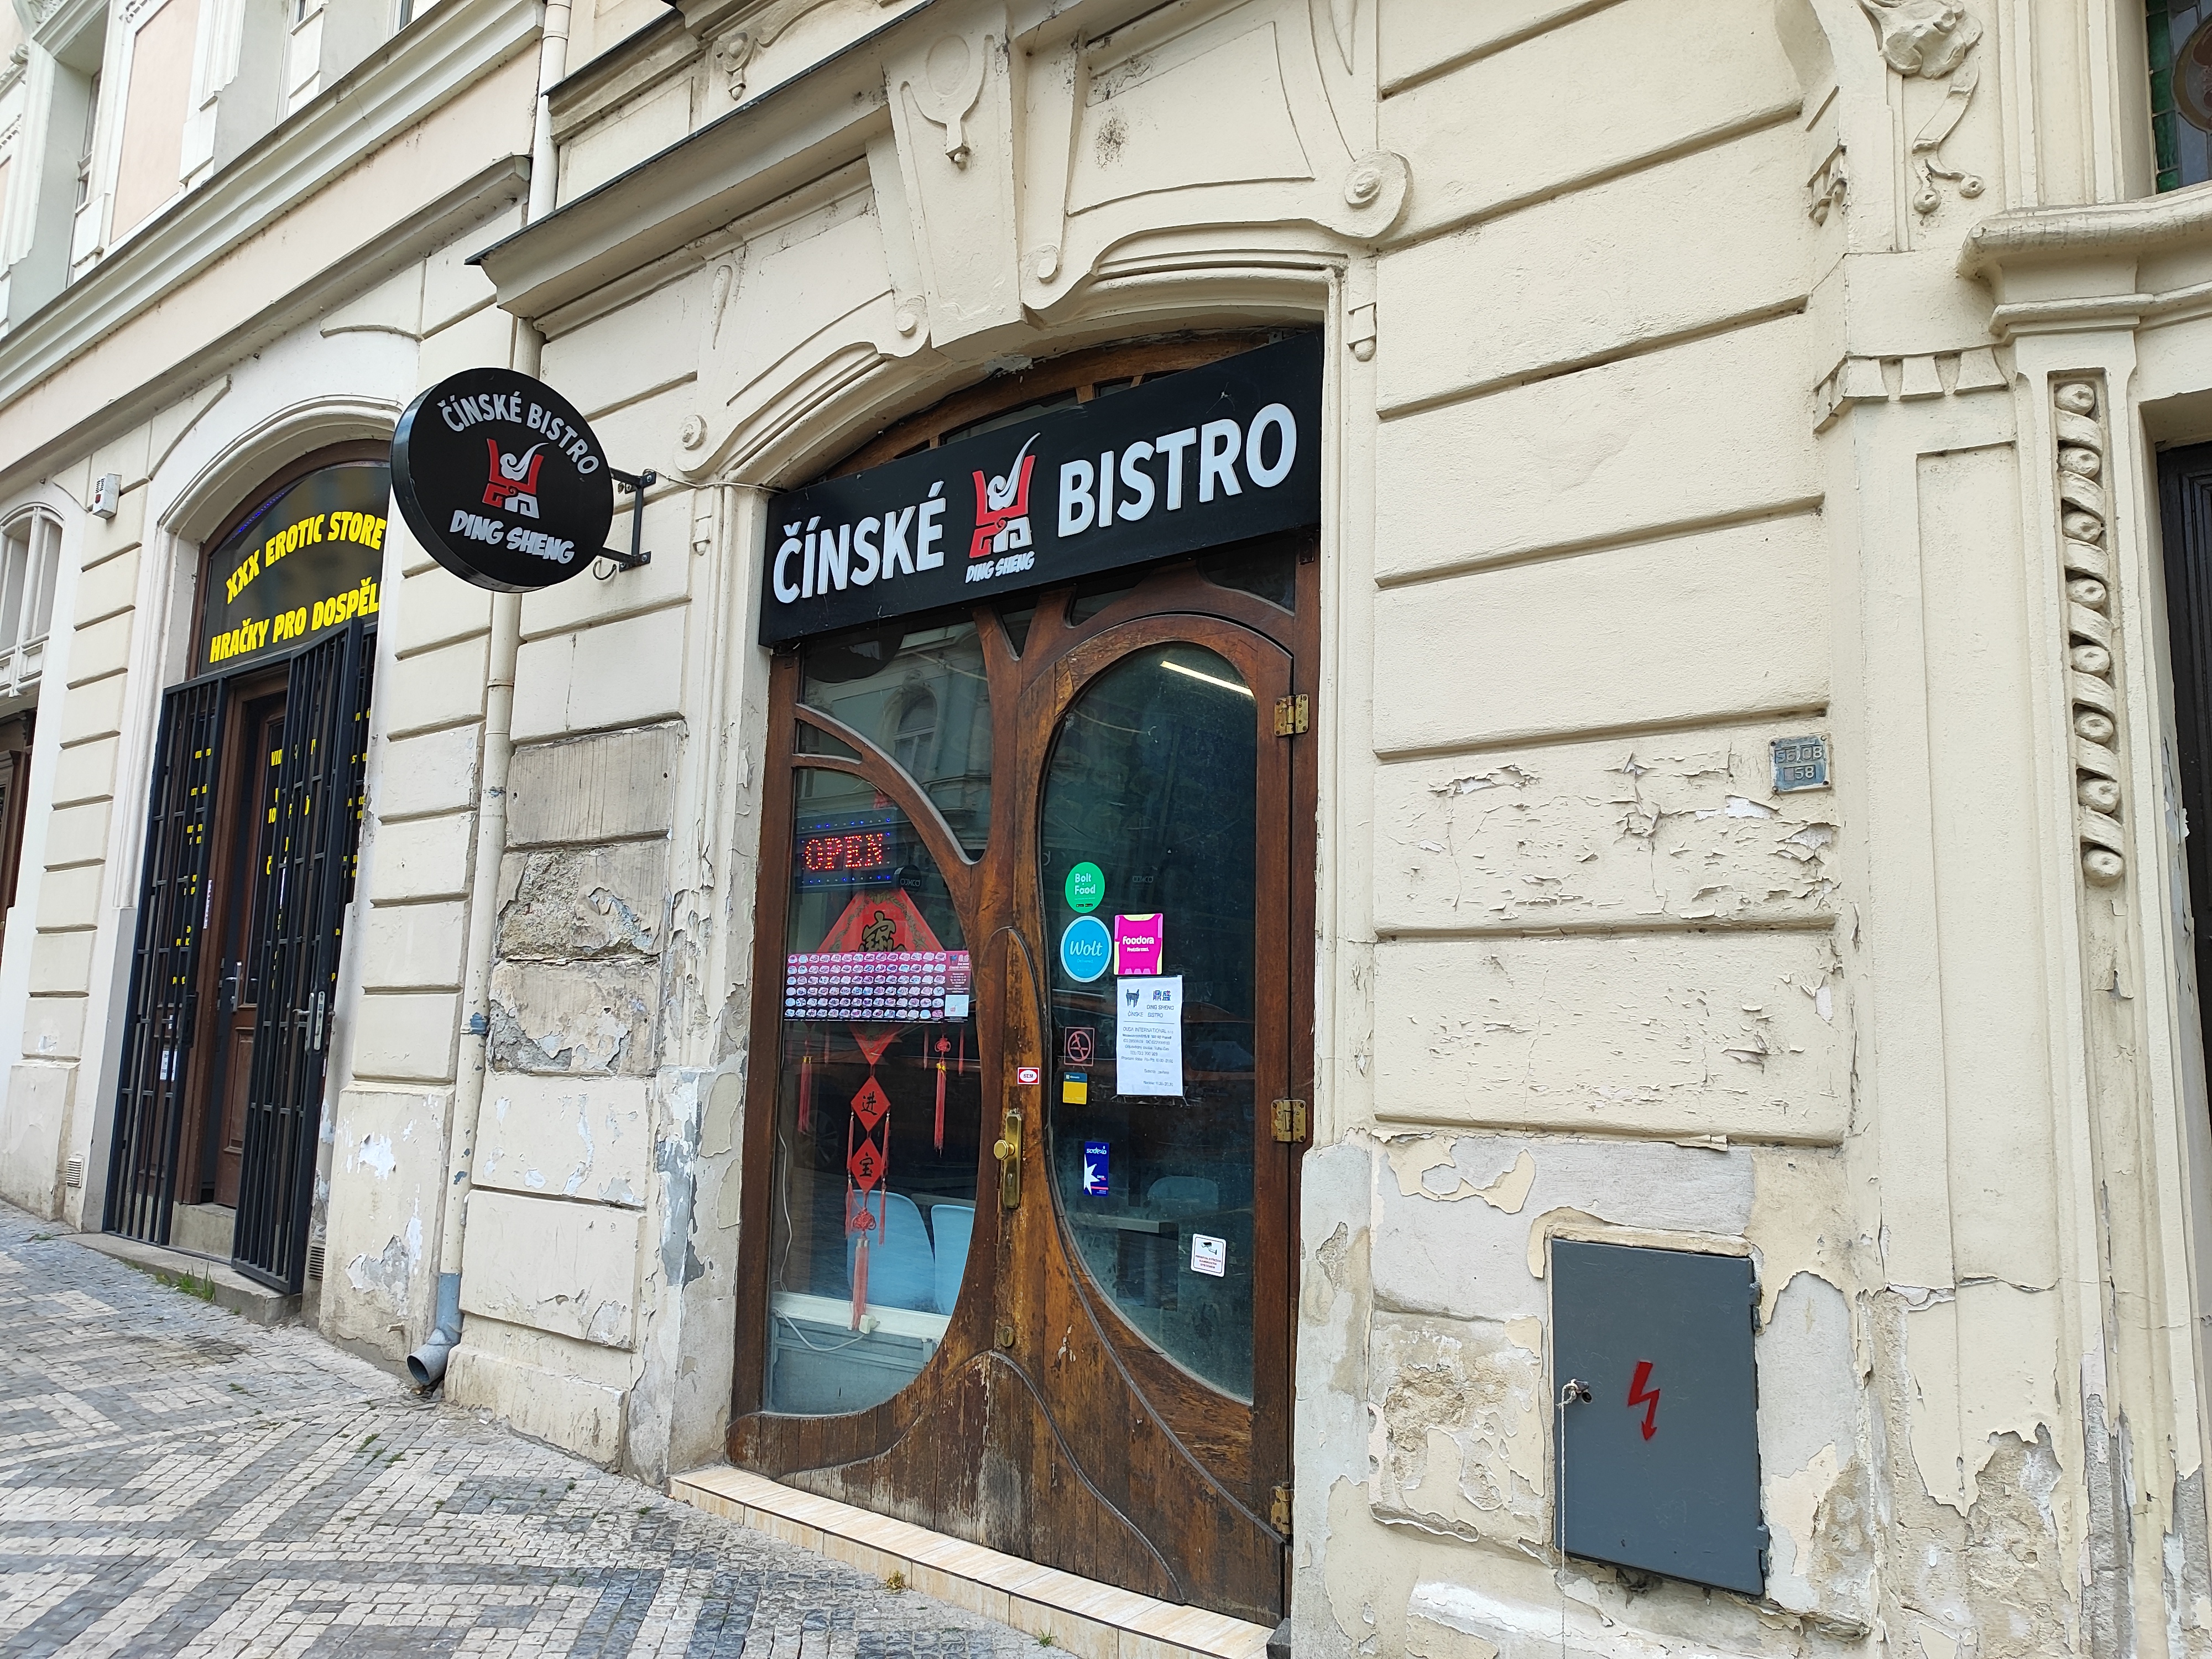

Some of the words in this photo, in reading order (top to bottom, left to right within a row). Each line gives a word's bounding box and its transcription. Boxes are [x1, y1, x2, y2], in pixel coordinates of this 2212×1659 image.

[437, 391, 523, 432] ČÍNSKÉ
[526, 402, 599, 474] BISTRO
[773, 481, 947, 603] ČÍNSKÉ
[1058, 403, 1297, 538] BISTRO
[449, 509, 504, 545] DING
[506, 526, 575, 564] SHENG
[226, 549, 260, 604] XXX
[265, 514, 325, 568] EROTIC
[327, 511, 387, 551] STORE
[965, 560, 995, 583] DING
[995, 551, 1035, 577] SHENG
[209, 618, 271, 664] HRAČKY
[273, 607, 307, 643] PRO
[311, 576, 380, 631] DOSPĚL
[1794, 765, 1815, 780] 58
[805, 833, 884, 870] OPEN
[1074, 873, 1092, 883] Bolt
[1074, 884, 1096, 895] Food
[1070, 940, 1103, 957] Wolt
[1123, 936, 1155, 945] foodora
[860, 1091, 878, 1116] 进
[1086, 1145, 1107, 1155] sodexo
[859, 1151, 874, 1178] 宝
